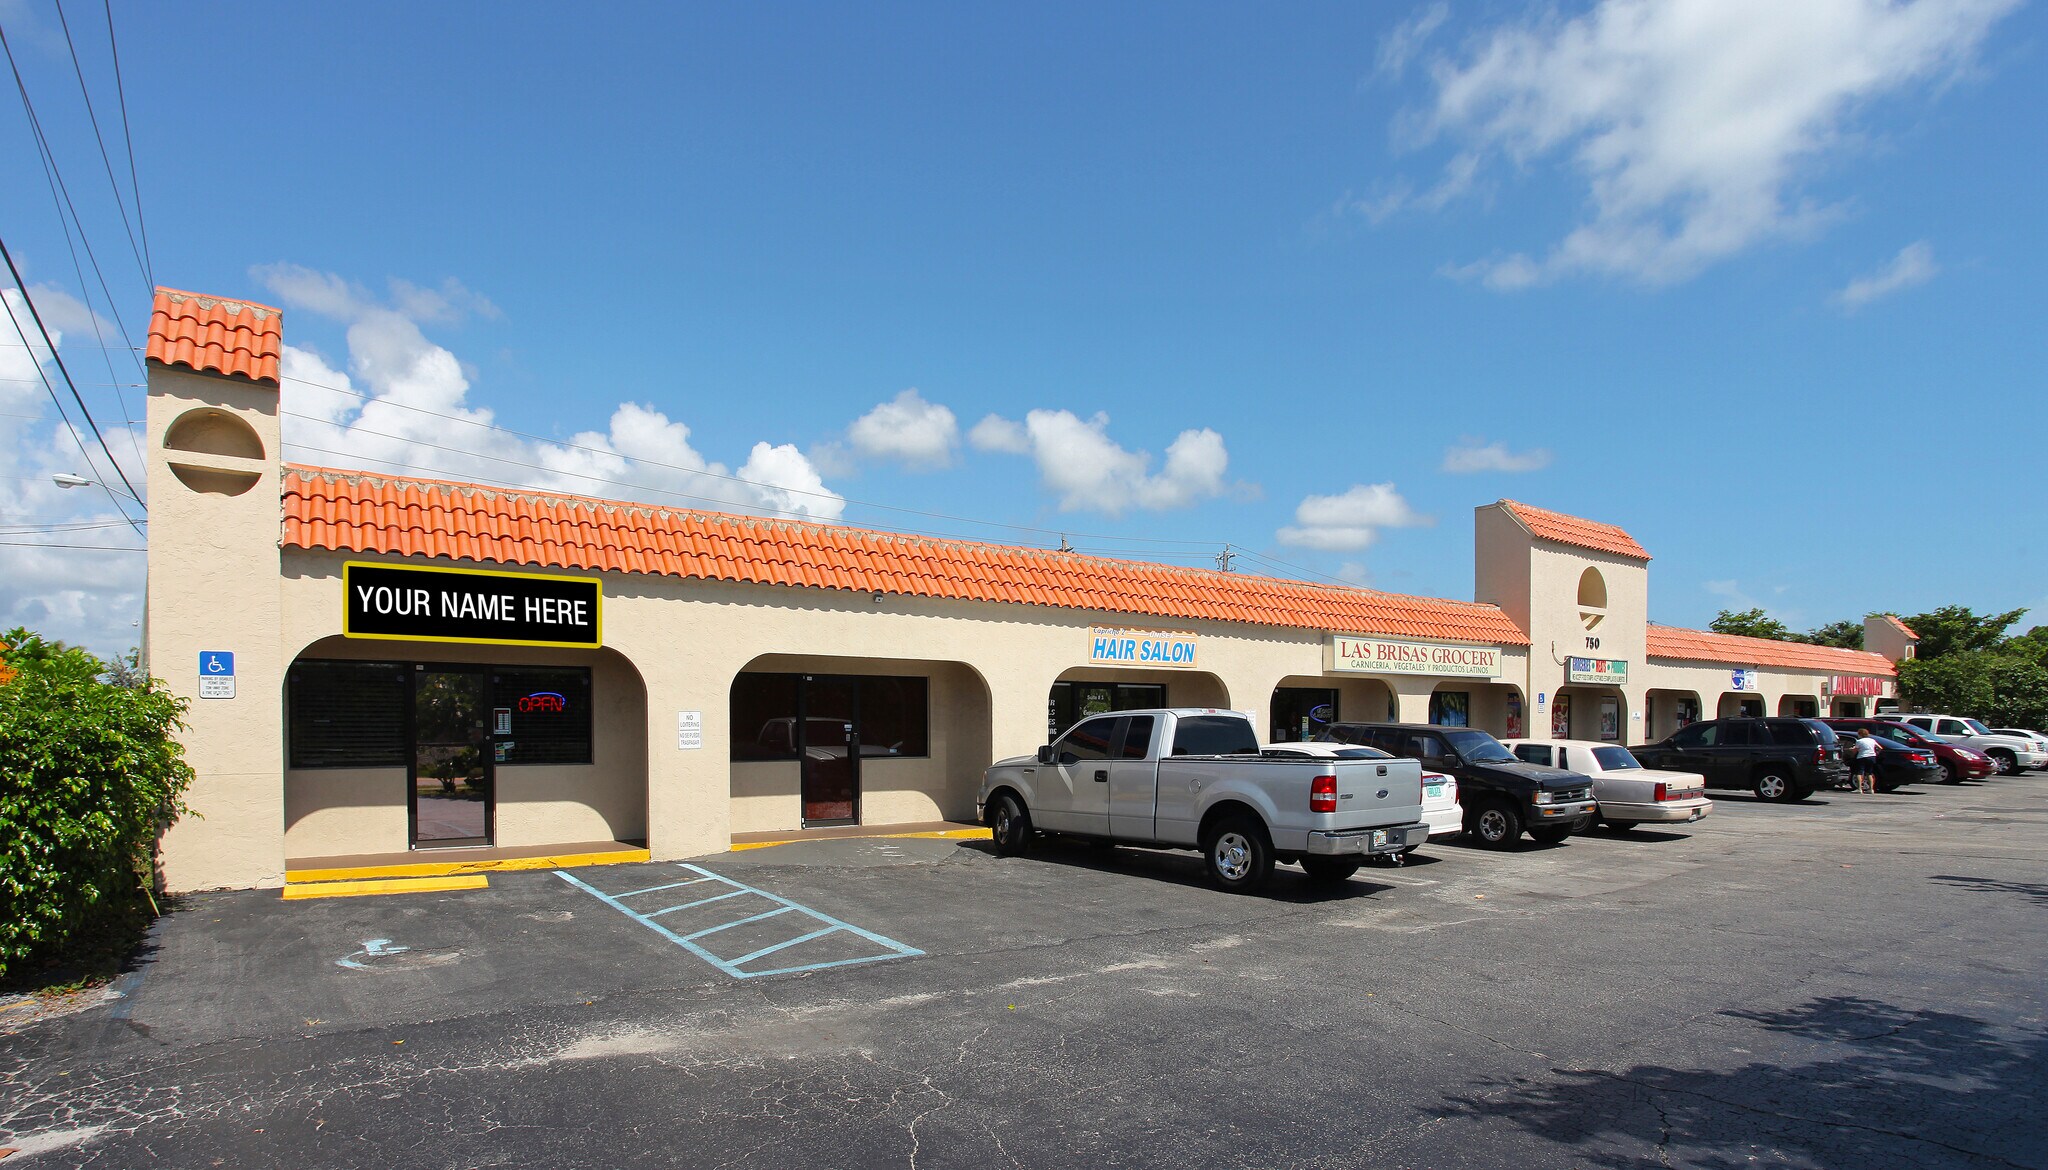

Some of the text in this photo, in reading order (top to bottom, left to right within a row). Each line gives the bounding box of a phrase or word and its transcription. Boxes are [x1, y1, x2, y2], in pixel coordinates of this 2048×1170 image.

[357, 585, 588, 626] YOUR NAME HERE
[1092, 638, 1196, 663] HAIR SALON
[1586, 636, 1600, 650] 750
[1341, 642, 1495, 666] LAS BRISAS GROCERY
[1351, 660, 1392, 670] CARNICERIA,
[1394, 662, 1425, 672] VEGETALES
[1432, 665, 1465, 673] PRODUCTOS
[1832, 676, 1886, 696] LAUNDROMAT
[518, 696, 563, 712] OPEN
